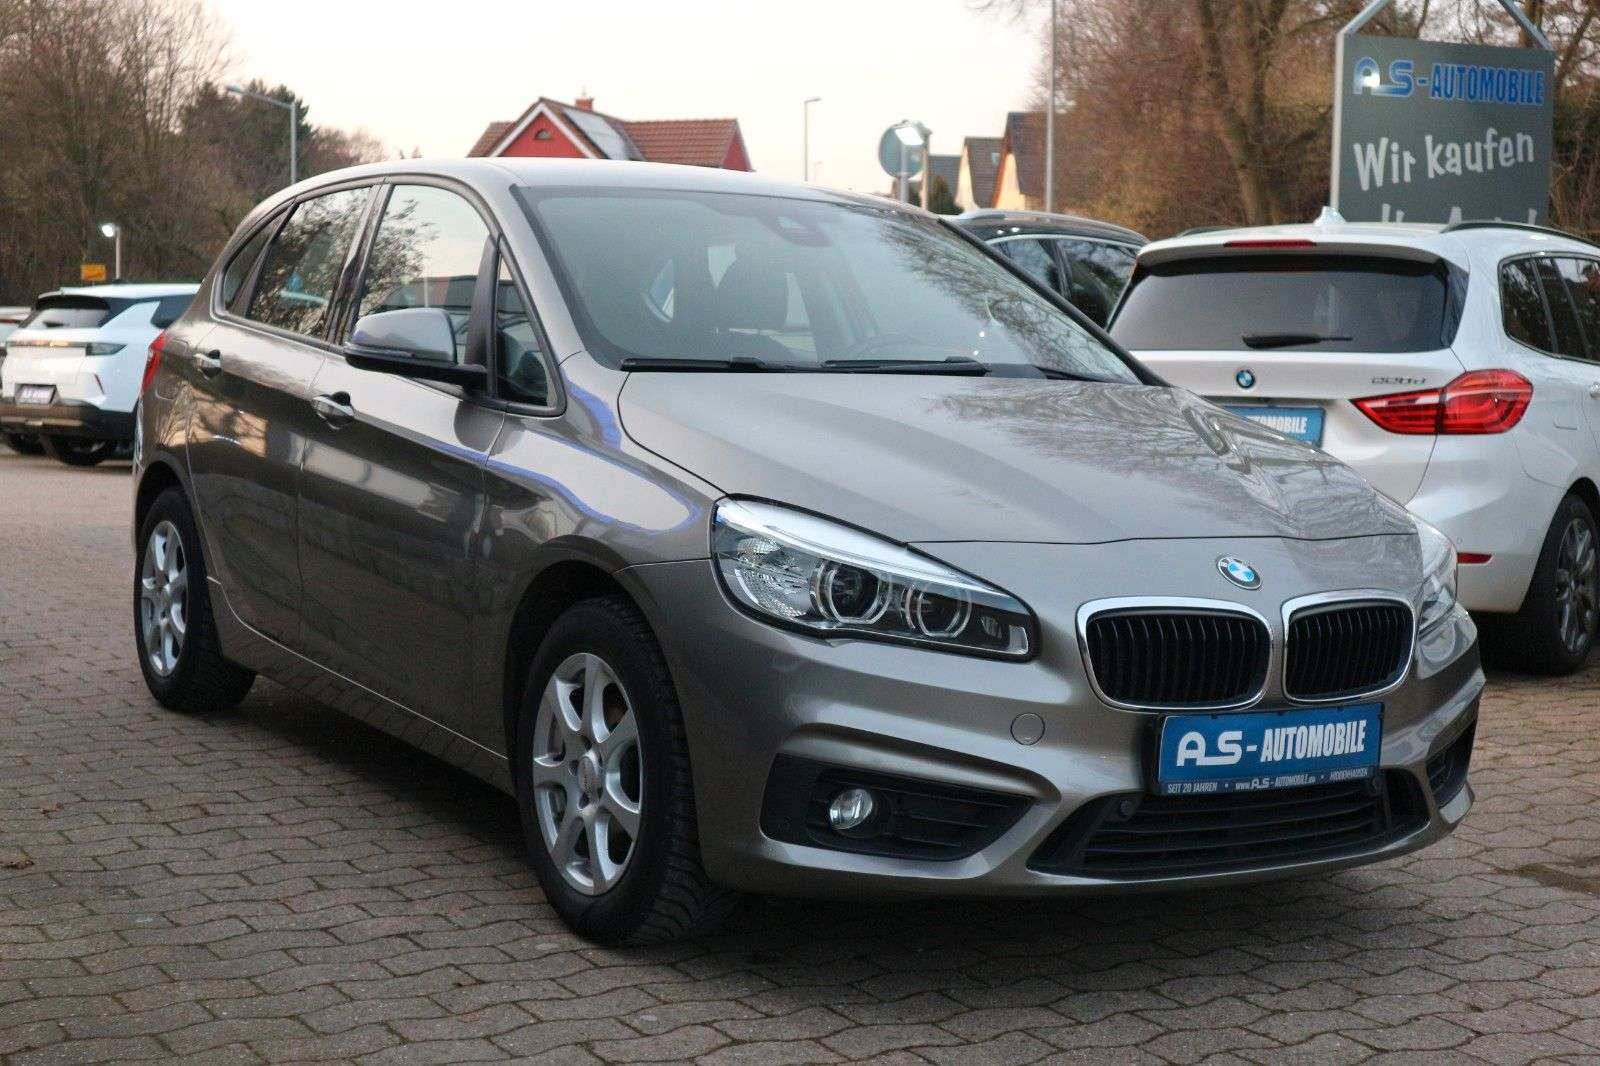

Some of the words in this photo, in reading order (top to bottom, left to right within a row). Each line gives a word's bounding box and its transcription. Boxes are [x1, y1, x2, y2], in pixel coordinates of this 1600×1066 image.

[1353, 137, 1416, 192] Wir
[1424, 127, 1534, 179] kaufen
[1167, 782, 1181, 794] SEIT
[1182, 782, 1192, 793] 20
[1193, 781, 1218, 793] JAHREN
